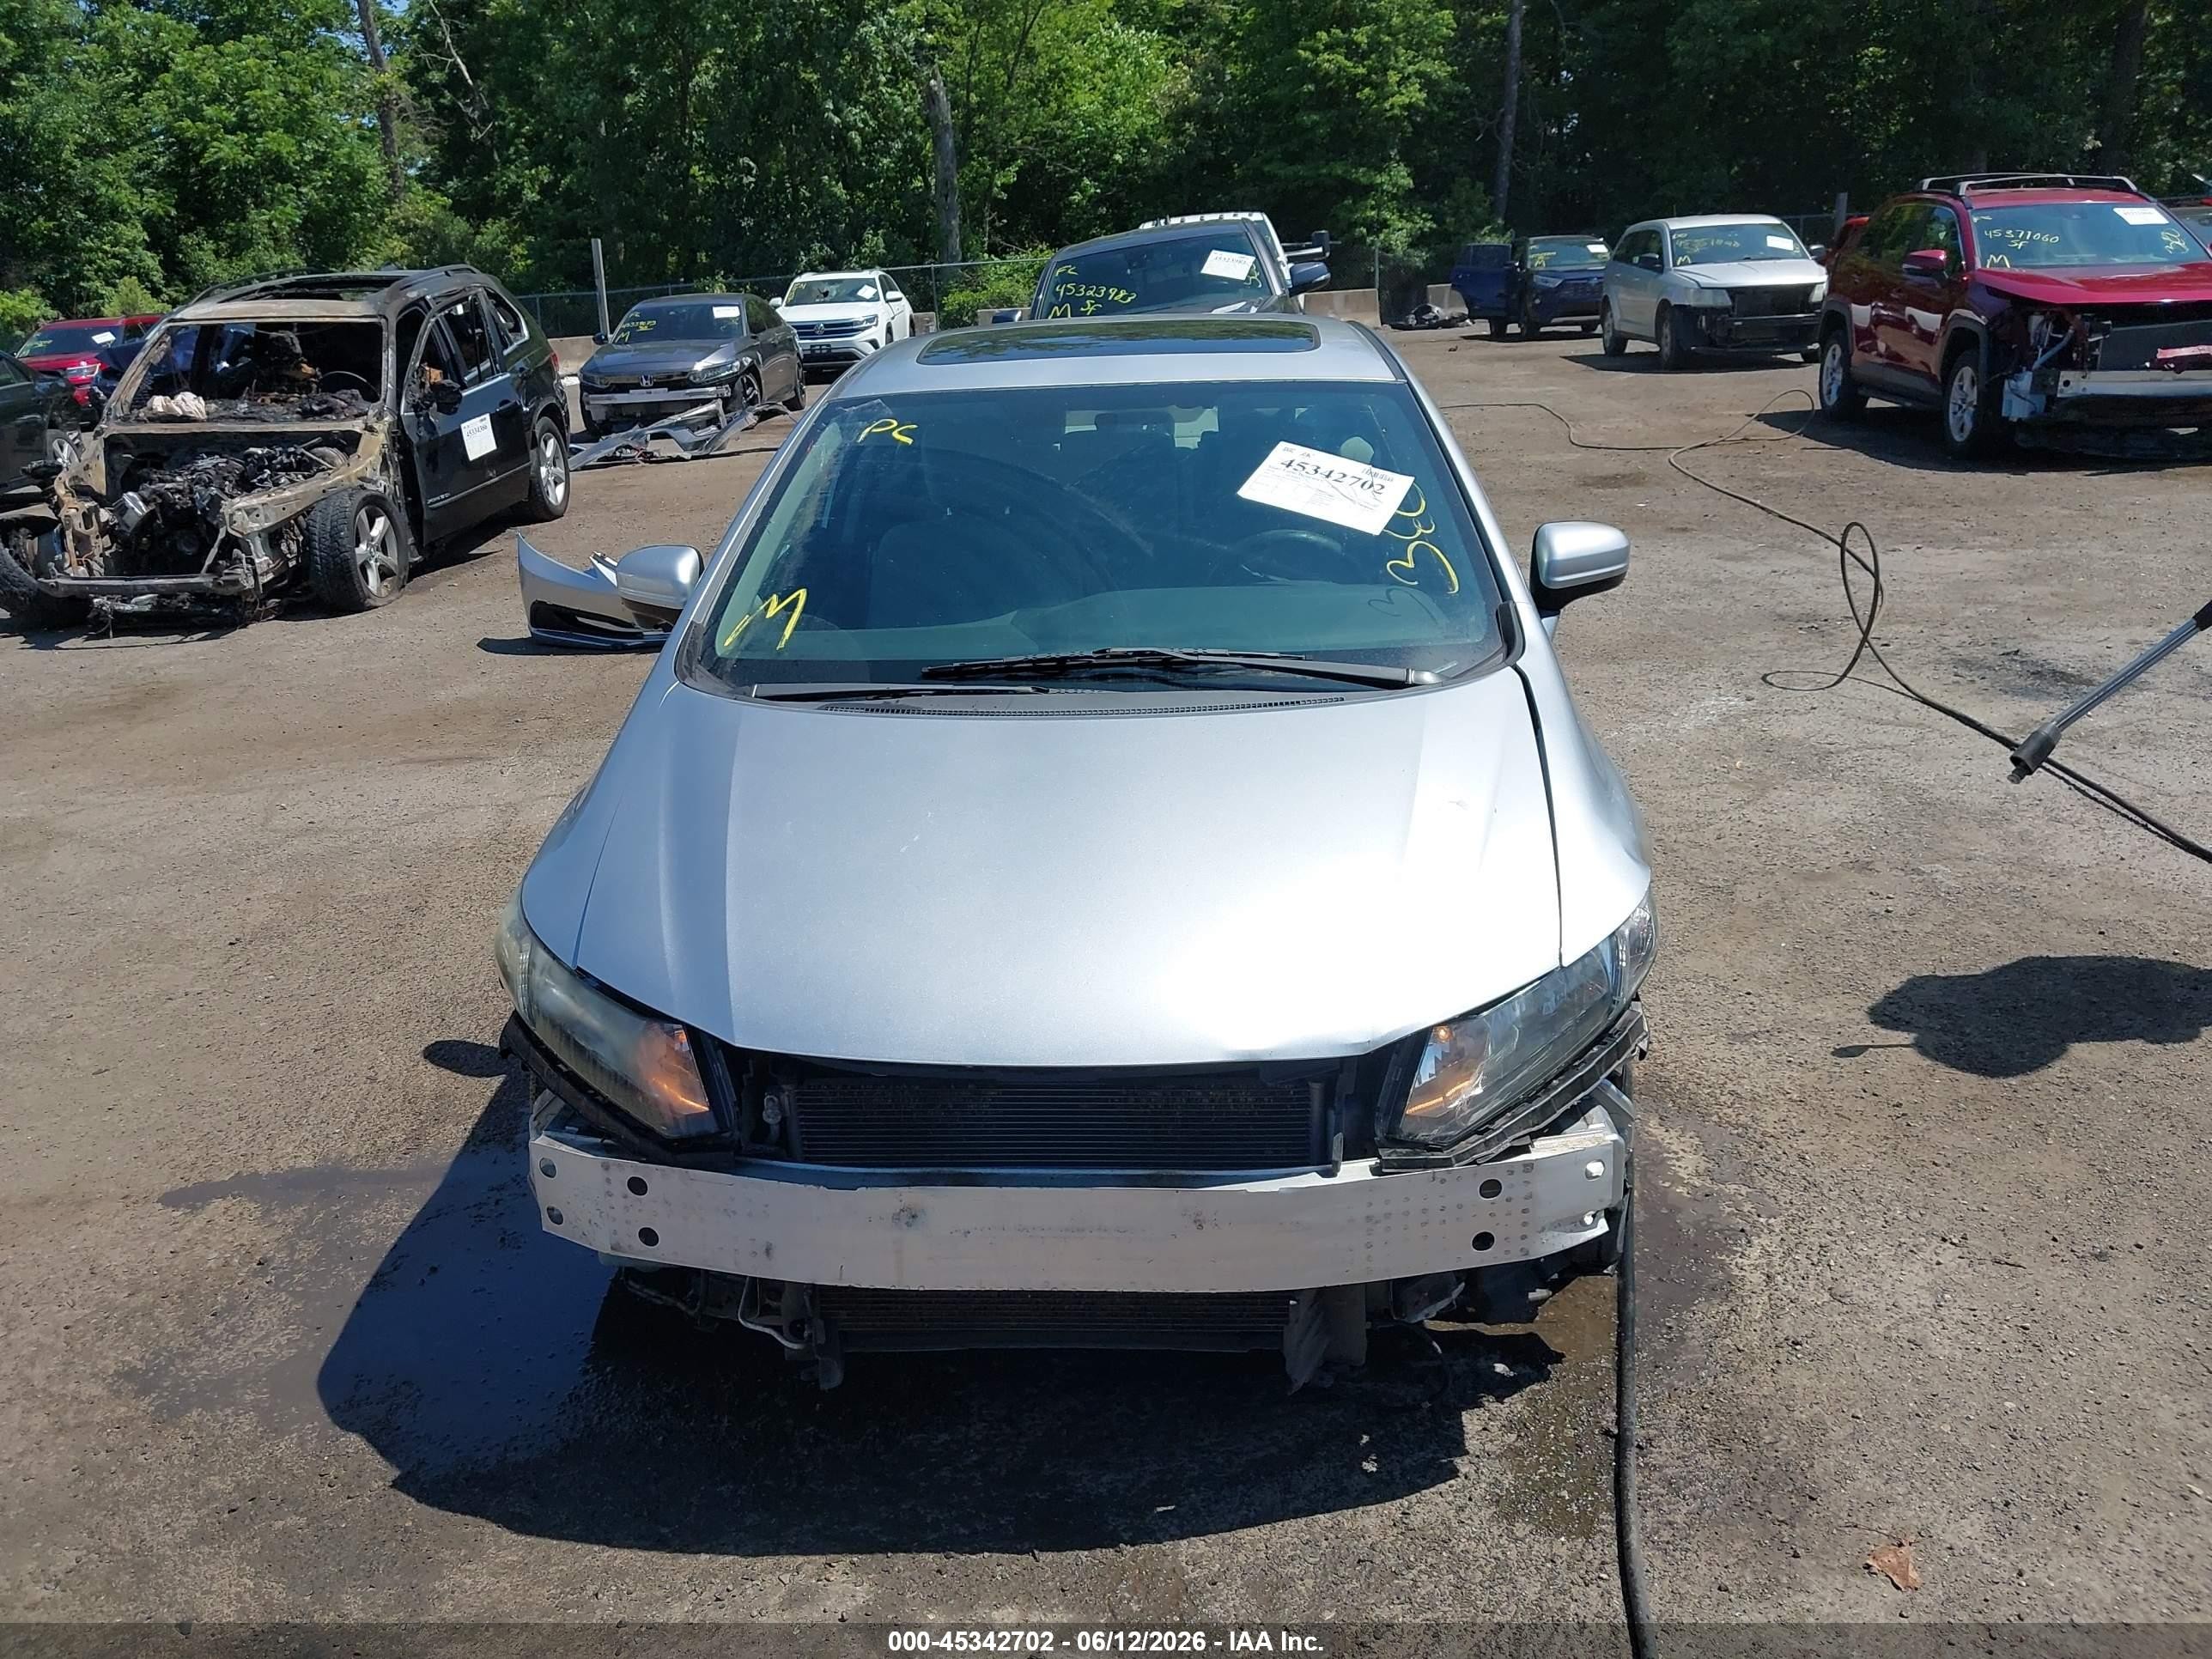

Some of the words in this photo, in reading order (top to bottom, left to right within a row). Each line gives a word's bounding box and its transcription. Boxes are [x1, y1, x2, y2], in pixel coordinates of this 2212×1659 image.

[1984, 228, 2060, 244] 45371060
[1985, 253, 2011, 269] M
[1054, 283, 1138, 304] 45323983
[1048, 302, 1073, 320] M
[614, 330, 631, 343] M
[856, 417, 920, 446] PC
[1279, 458, 1387, 495] 45342702
[723, 587, 808, 652] M
